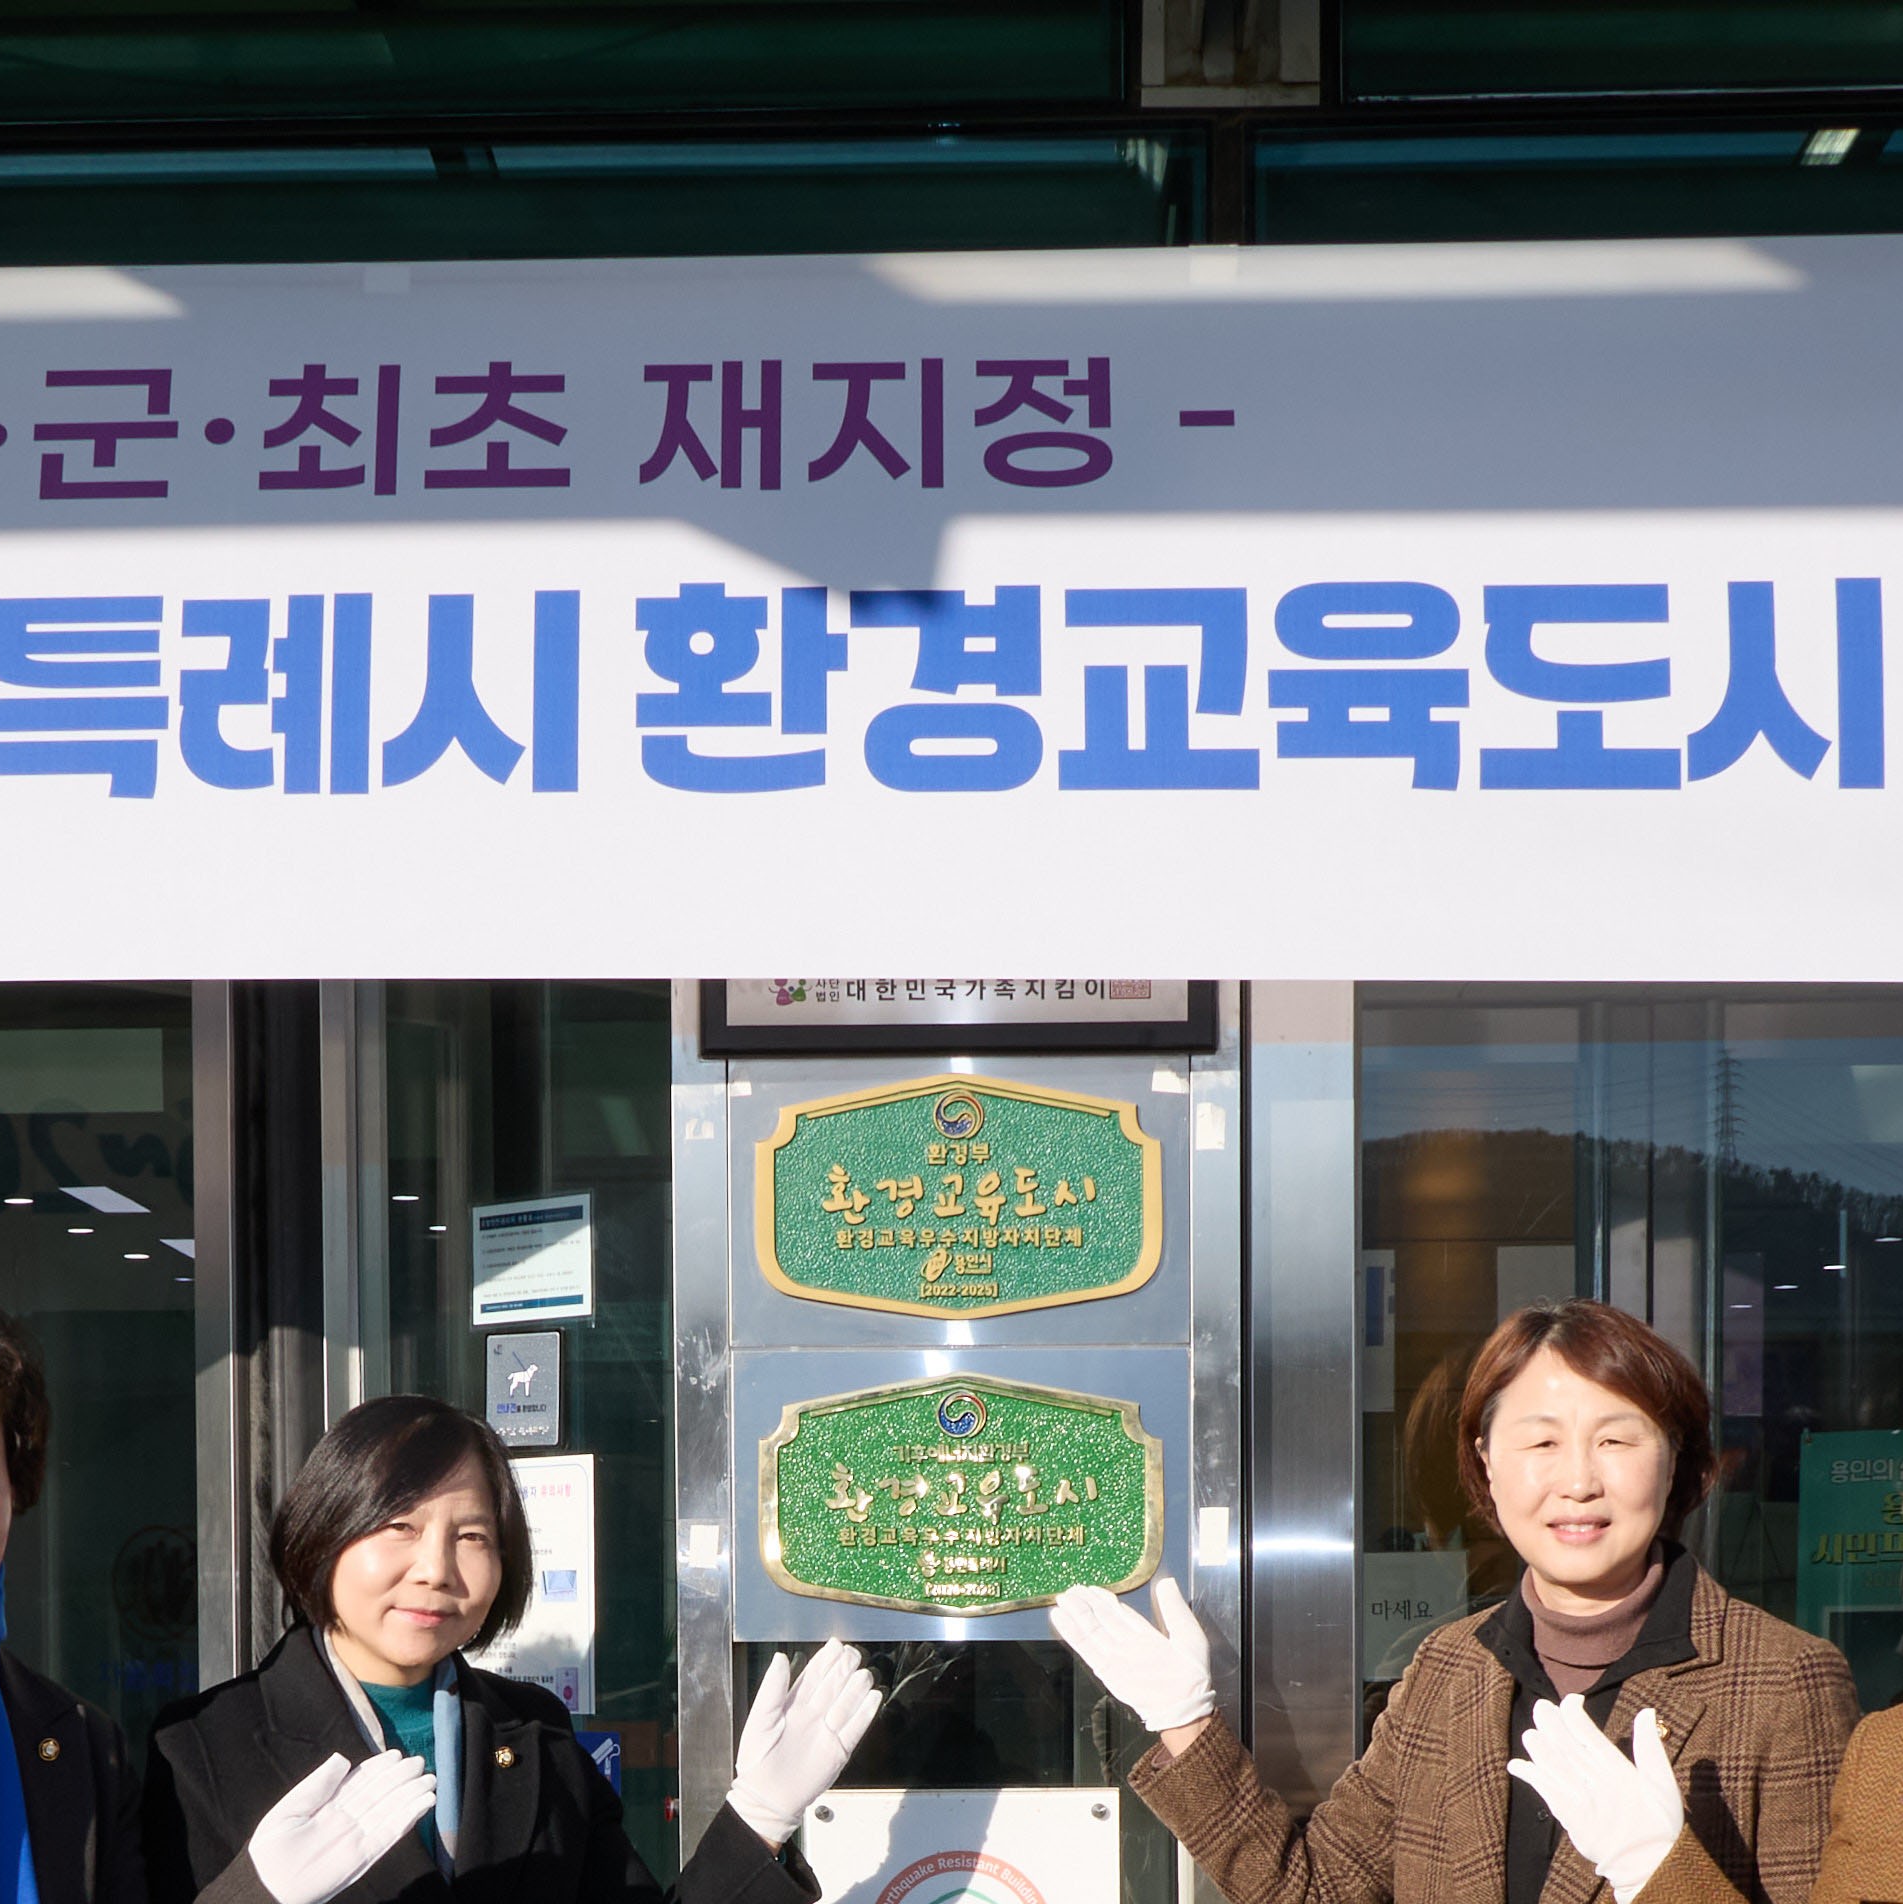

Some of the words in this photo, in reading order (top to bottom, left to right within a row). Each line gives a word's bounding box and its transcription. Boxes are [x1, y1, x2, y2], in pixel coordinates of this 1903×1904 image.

[640, 357, 1114, 490] 재지정
[636, 576, 1884, 794] 환경교육도시
[927, 1143, 991, 1166] 환경부
[822, 1164, 1096, 1226] 환경교육도시
[836, 1228, 1083, 1250] 환경교육우수지방자치단체
[954, 1254, 993, 1275] 용인시
[825, 1462, 1098, 1525] 환경교육도시
[937, 1854, 1000, 1876] Resistant
